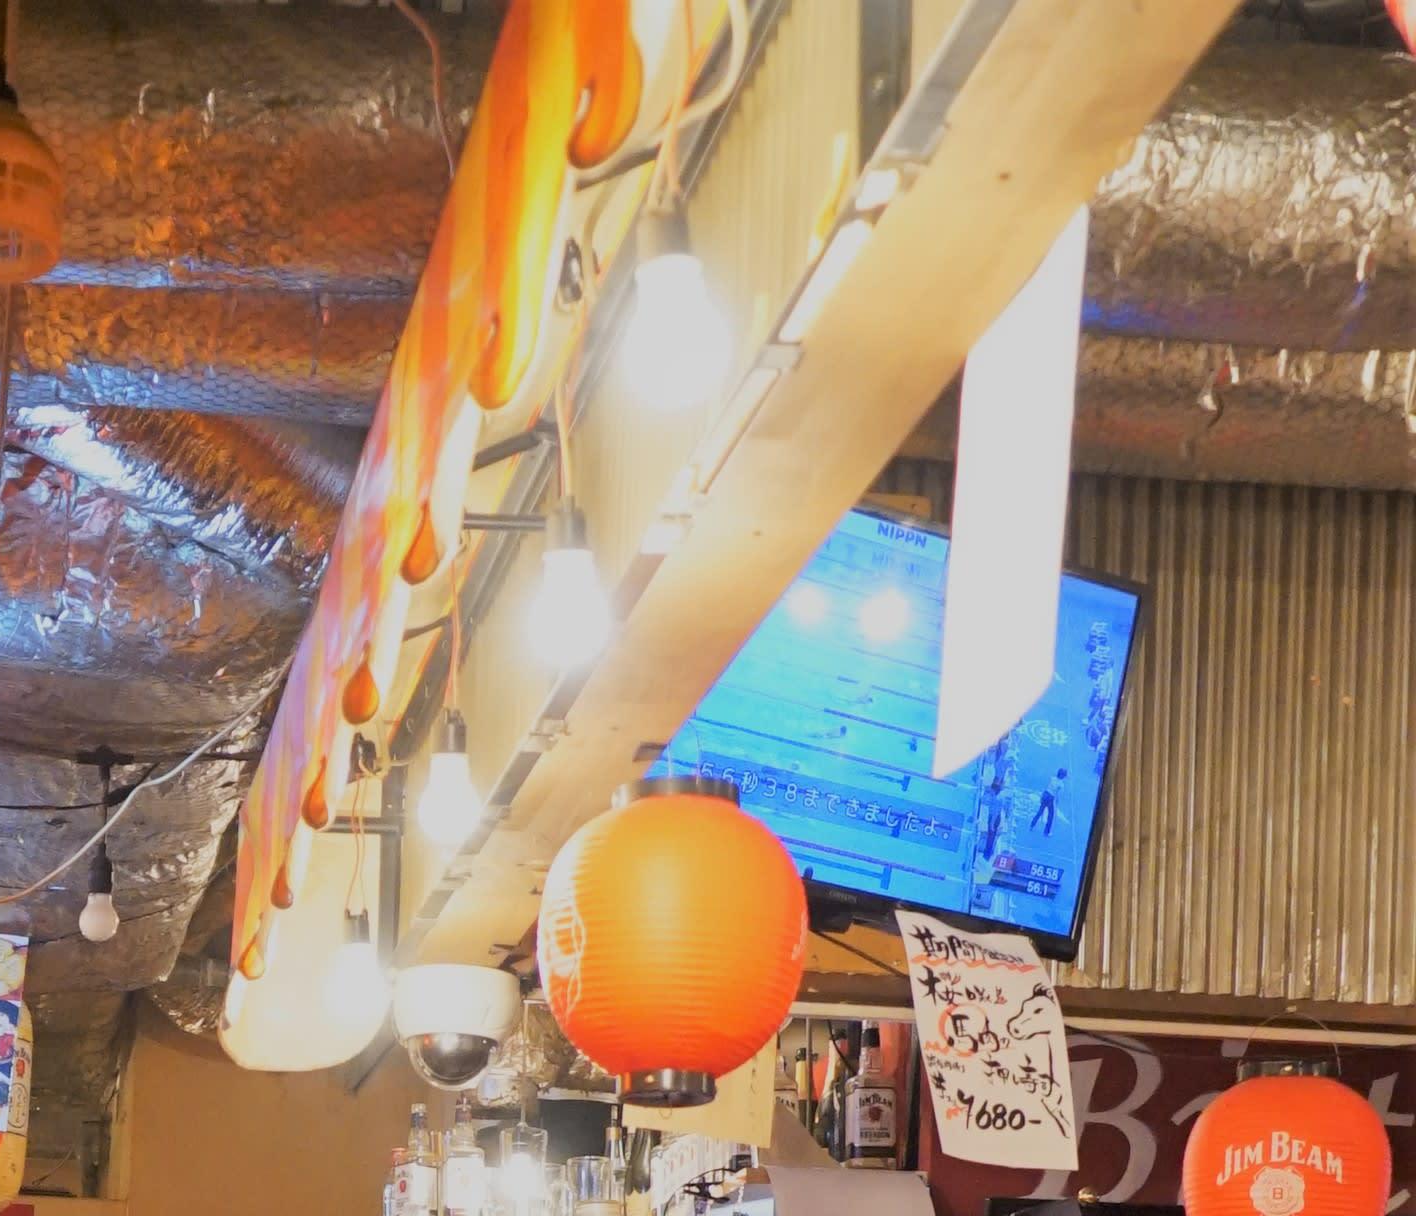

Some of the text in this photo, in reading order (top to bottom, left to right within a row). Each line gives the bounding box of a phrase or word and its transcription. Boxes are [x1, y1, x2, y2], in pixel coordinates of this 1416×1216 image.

[876, 522, 927, 548] NIPPN
[1216, 1131, 1344, 1187] JIM BEAM
